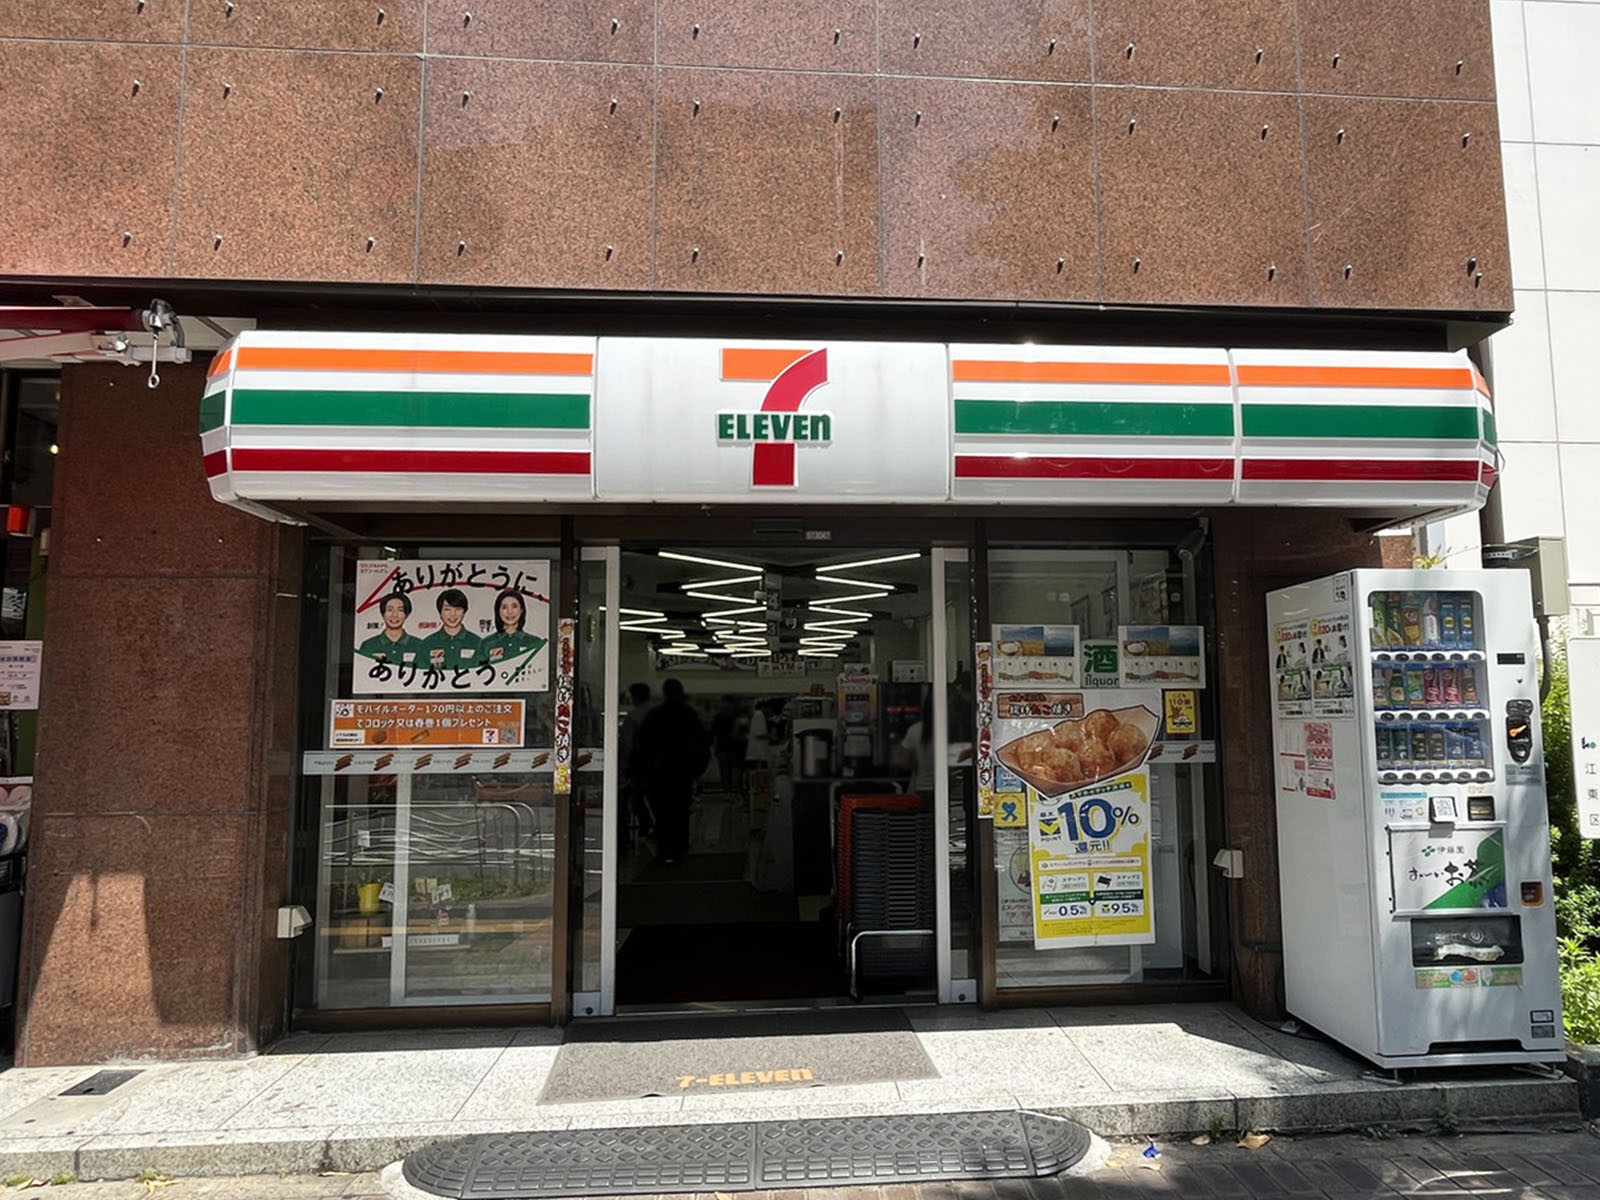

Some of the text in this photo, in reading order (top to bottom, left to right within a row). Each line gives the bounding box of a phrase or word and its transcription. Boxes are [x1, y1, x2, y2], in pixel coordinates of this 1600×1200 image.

[392, 562, 540, 598] ありがとうに
[1084, 644, 1118, 673] 酒
[1085, 674, 1119, 687] liquor
[1585, 762, 1600, 826] 江東区
[1058, 798, 1139, 841] 10%
